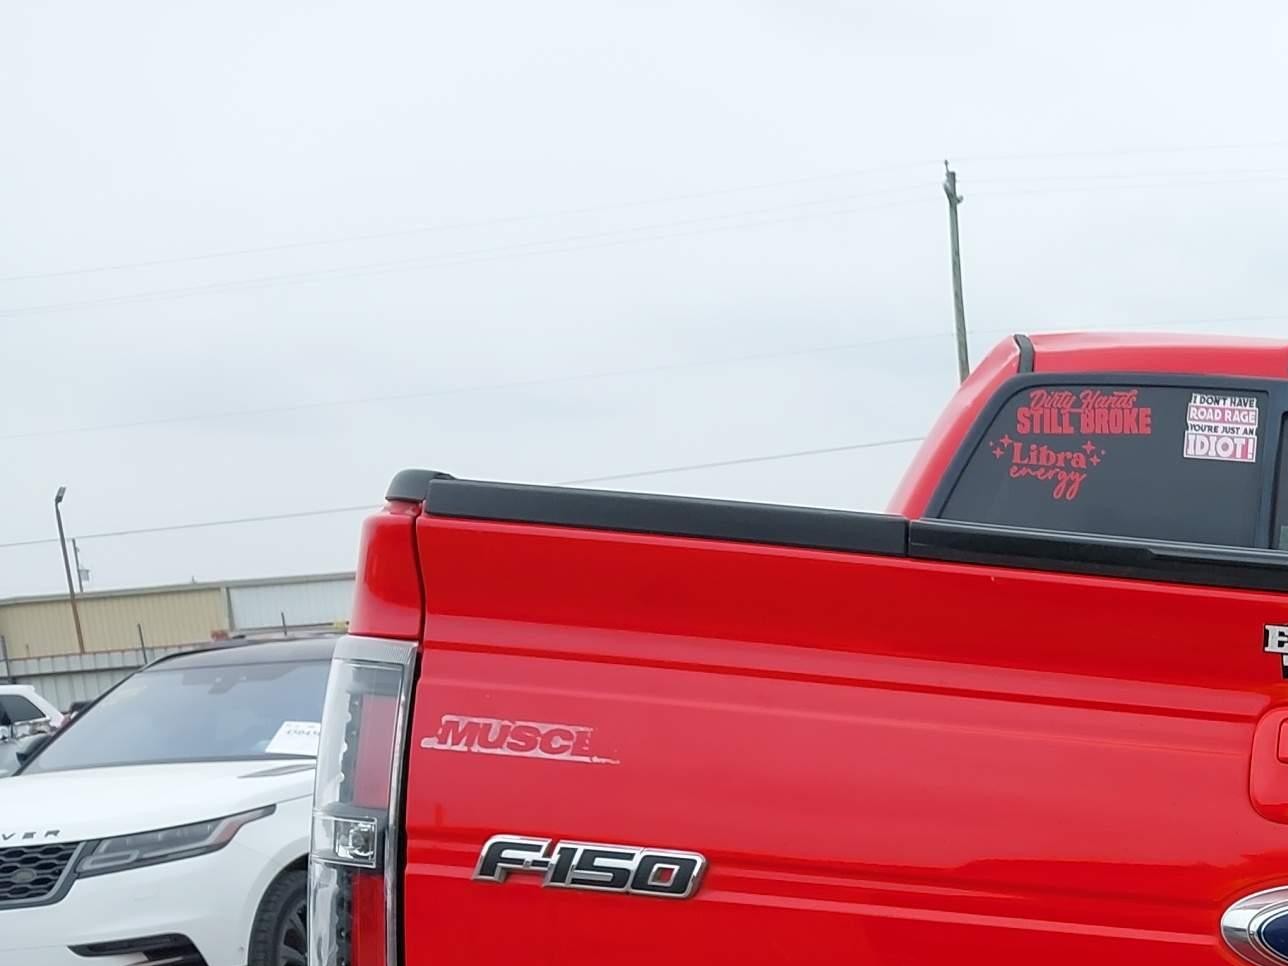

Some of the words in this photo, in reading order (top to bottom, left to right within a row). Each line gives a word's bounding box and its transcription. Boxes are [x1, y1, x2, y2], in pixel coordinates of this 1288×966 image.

[1189, 407, 1222, 422] ROAD
[1224, 409, 1256, 424] RAGE
[1230, 398, 1255, 408] HAVE
[1017, 407, 1074, 434] STILL
[1080, 408, 1151, 434] BROKE
[1190, 424, 1220, 433] YOU'RE
[1242, 428, 1255, 436] AN
[1012, 442, 1087, 469] Libra
[1186, 434, 1254, 459] IDIOT!
[1009, 465, 1087, 500] energy
[472, 834, 707, 898] F-150
